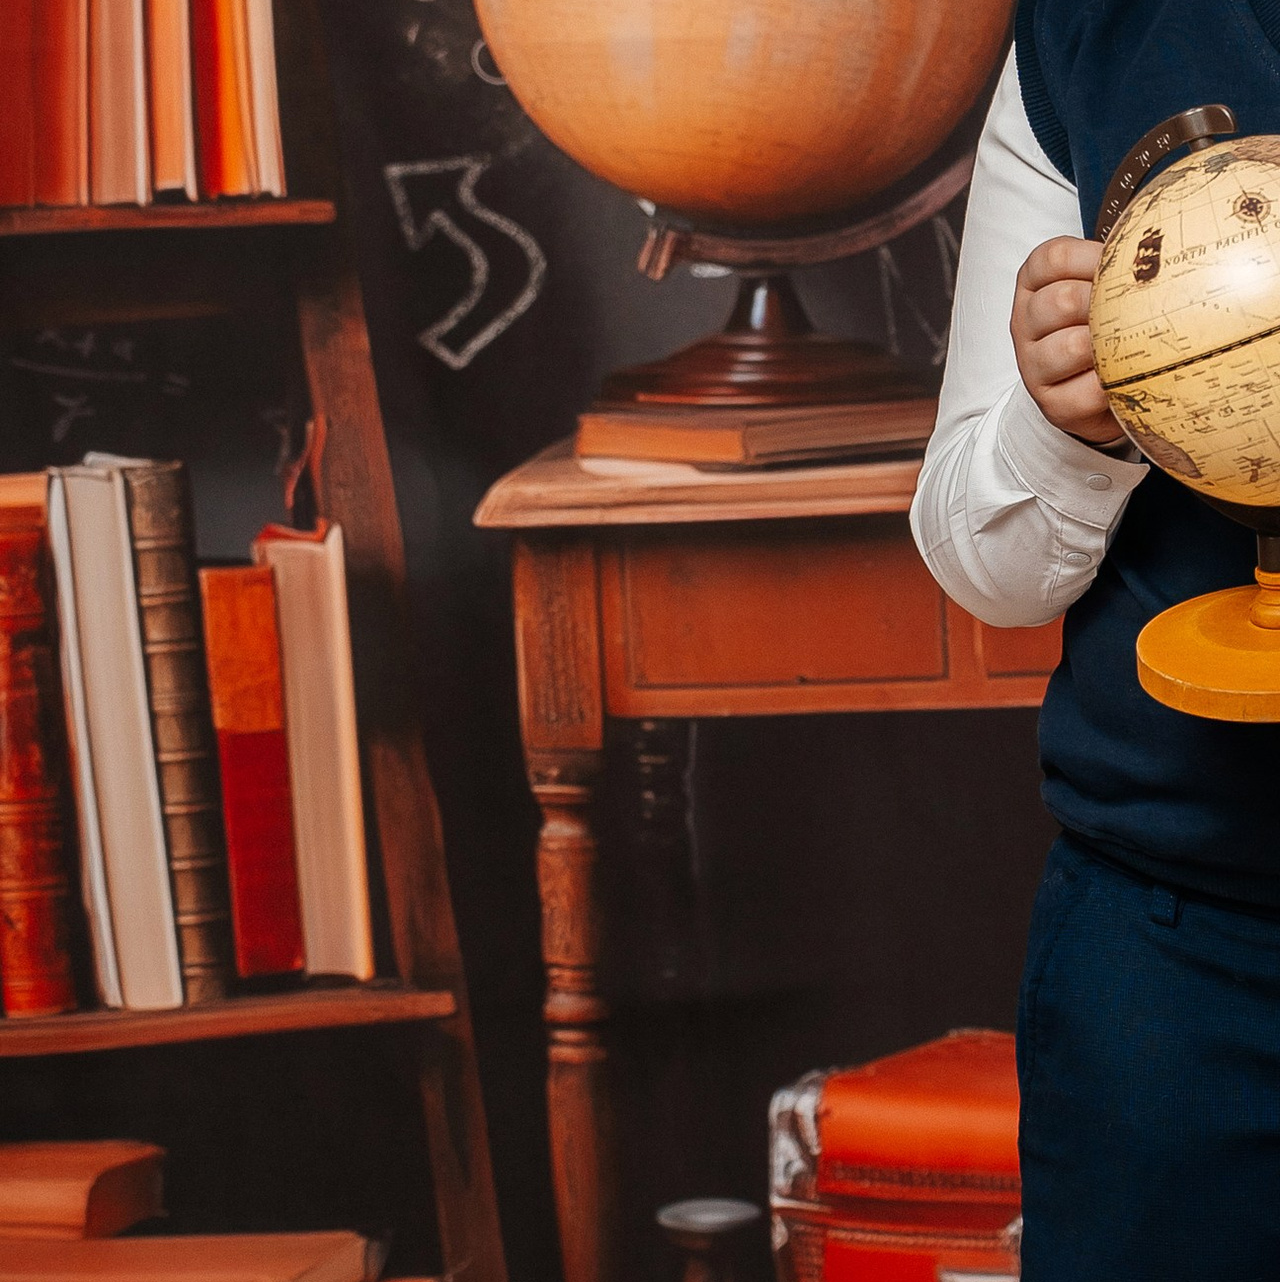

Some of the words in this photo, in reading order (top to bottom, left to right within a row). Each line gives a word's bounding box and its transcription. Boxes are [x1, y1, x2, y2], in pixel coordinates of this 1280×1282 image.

[1135, 150, 1151, 168] 70
[1120, 172, 1135, 190] 60
[1163, 246, 1207, 269] NORTH
[1215, 225, 1269, 251] PACIFIC
